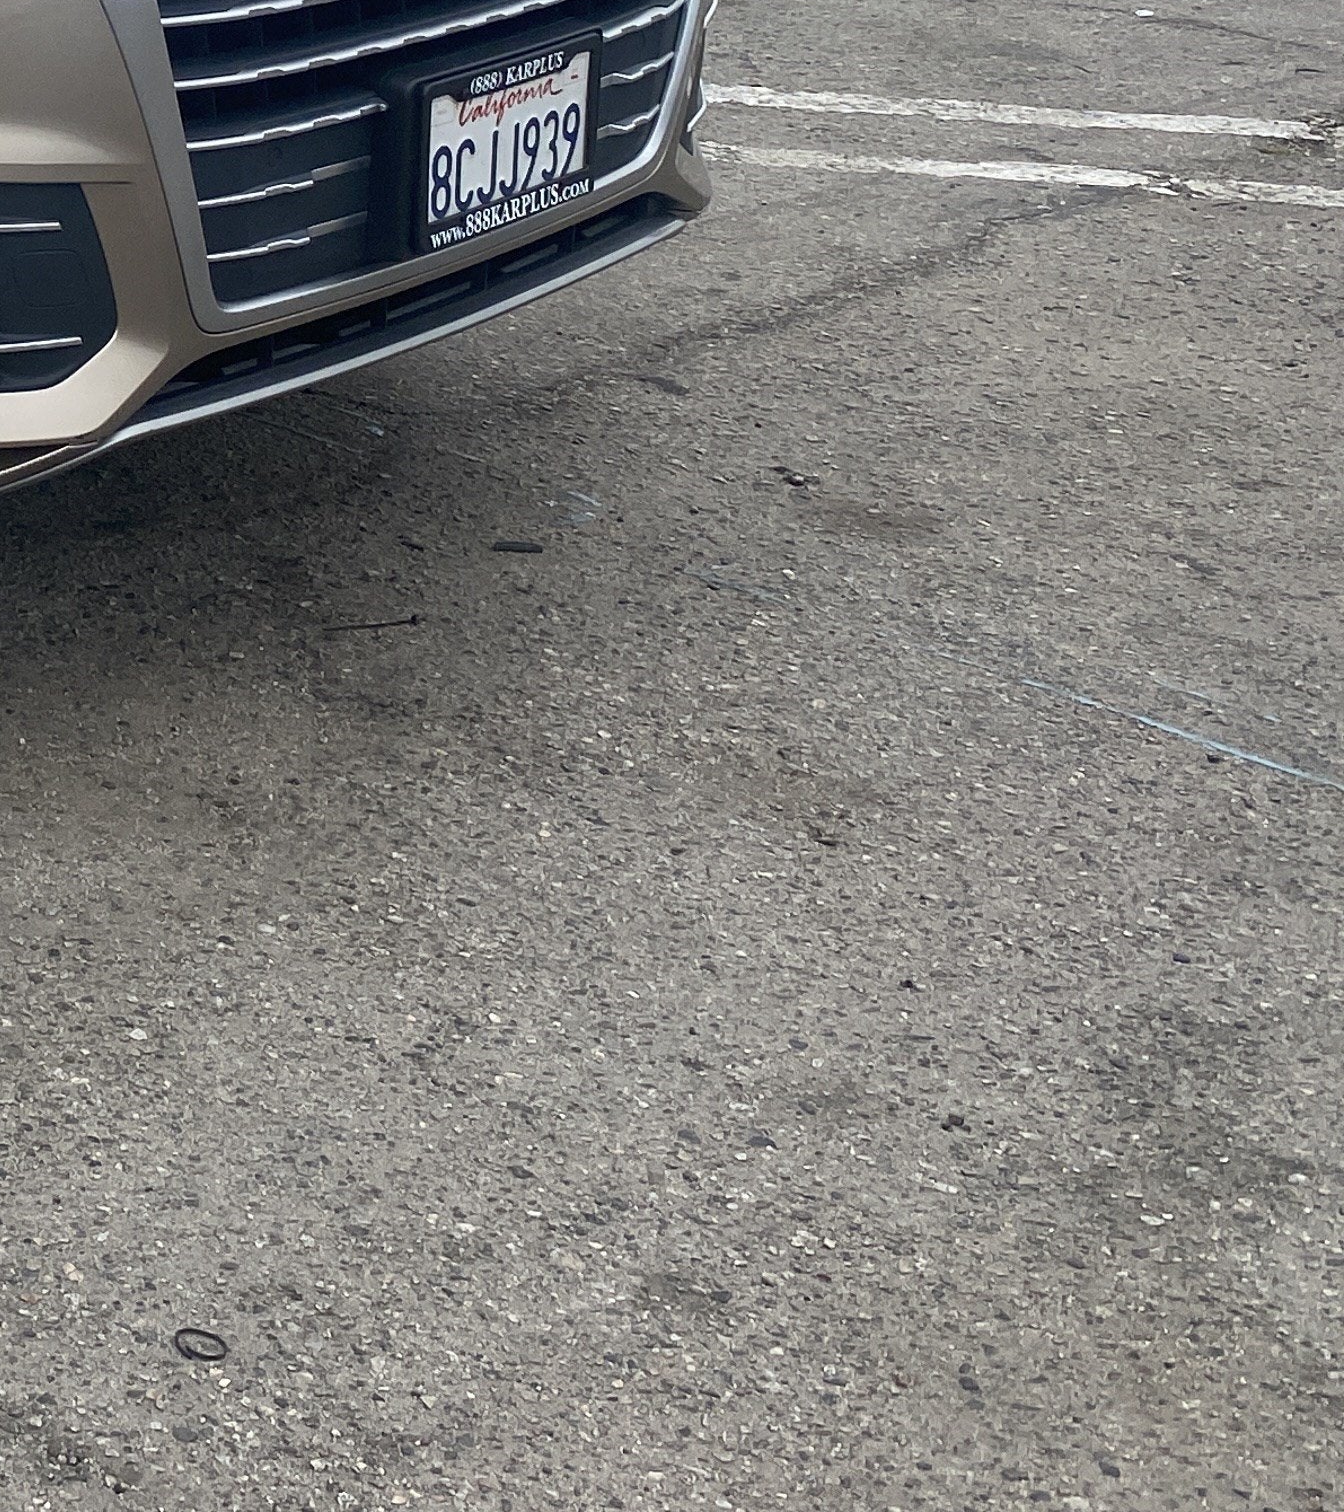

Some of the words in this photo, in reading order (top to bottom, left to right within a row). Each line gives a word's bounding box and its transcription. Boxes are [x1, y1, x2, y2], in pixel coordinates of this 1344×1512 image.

[470, 71, 503, 94] (888)
[505, 51, 564, 86] KARPLUS
[458, 77, 563, 126] California
[430, 102, 581, 219] 8CJJ939
